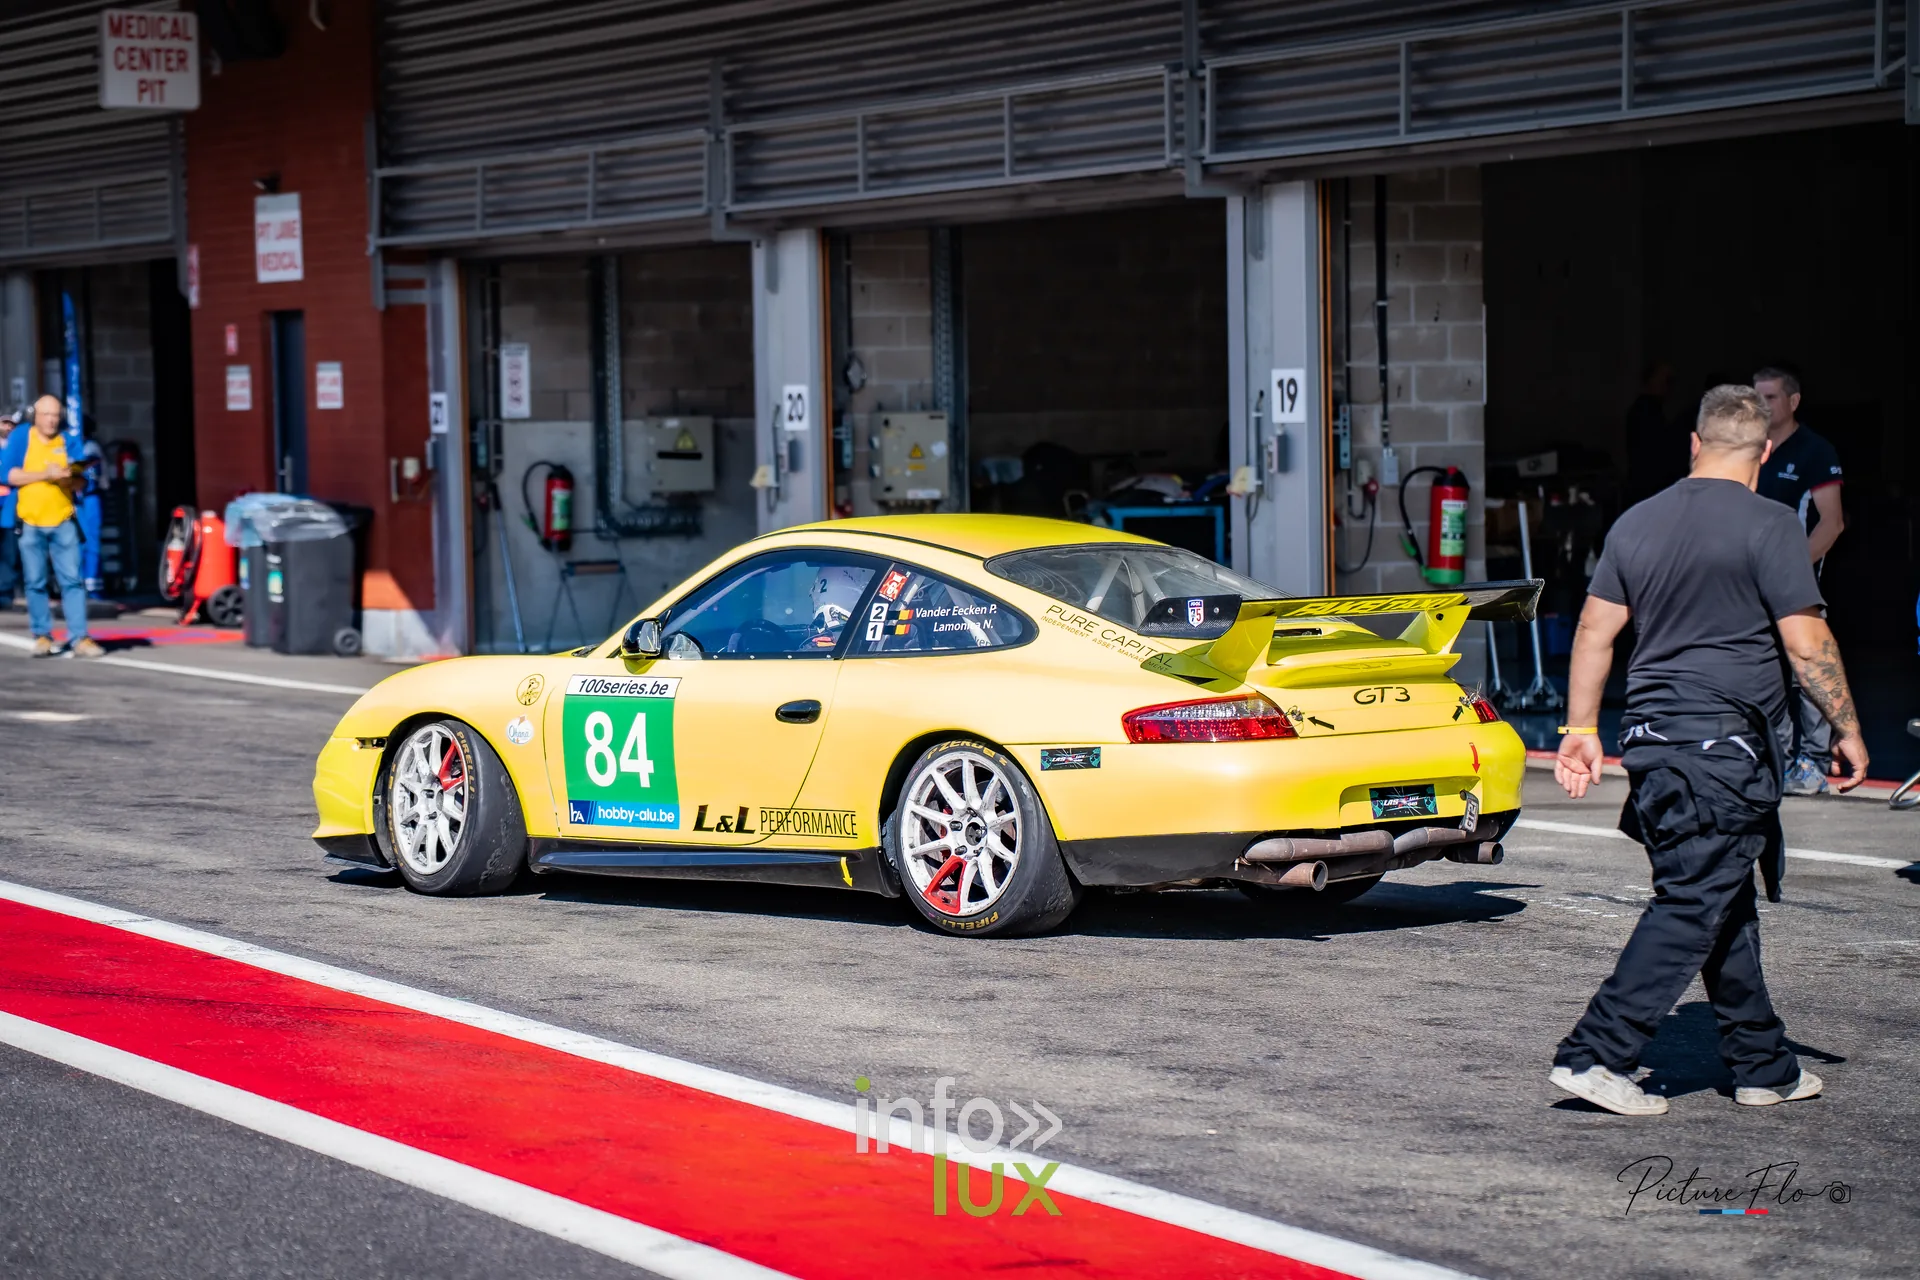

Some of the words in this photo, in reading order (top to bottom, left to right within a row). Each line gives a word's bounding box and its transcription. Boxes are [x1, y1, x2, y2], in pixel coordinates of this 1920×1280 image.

[108, 13, 193, 41] MEDICAL
[113, 46, 189, 73] CENTER
[137, 78, 167, 104] PIT
[788, 393, 805, 421] 20
[1277, 377, 1298, 413] 19
[872, 605, 885, 620] 2
[915, 606, 951, 618] Vander
[952, 604, 987, 616] Eecken
[989, 603, 997, 614] P.
[870, 624, 878, 639] 1
[983, 619, 994, 629] N.
[1046, 604, 1100, 633] PURE
[1101, 629, 1173, 668] CAPITAL
[1041, 615, 1090, 639] INDEPENDENT
[1092, 638, 1116, 651] ASSET
[1117, 648, 1170, 673] MANAGMENT
[578, 678, 669, 696] 100series.be
[1353, 686, 1410, 705] GT3
[456, 730, 475, 794] PIRELLI
[584, 711, 654, 788] 84
[598, 805, 675, 823] hobby-alu.be
[693, 804, 756, 834] L&L
[760, 810, 858, 835] PERFORMANCE
[943, 911, 999, 930] PIRELLI
